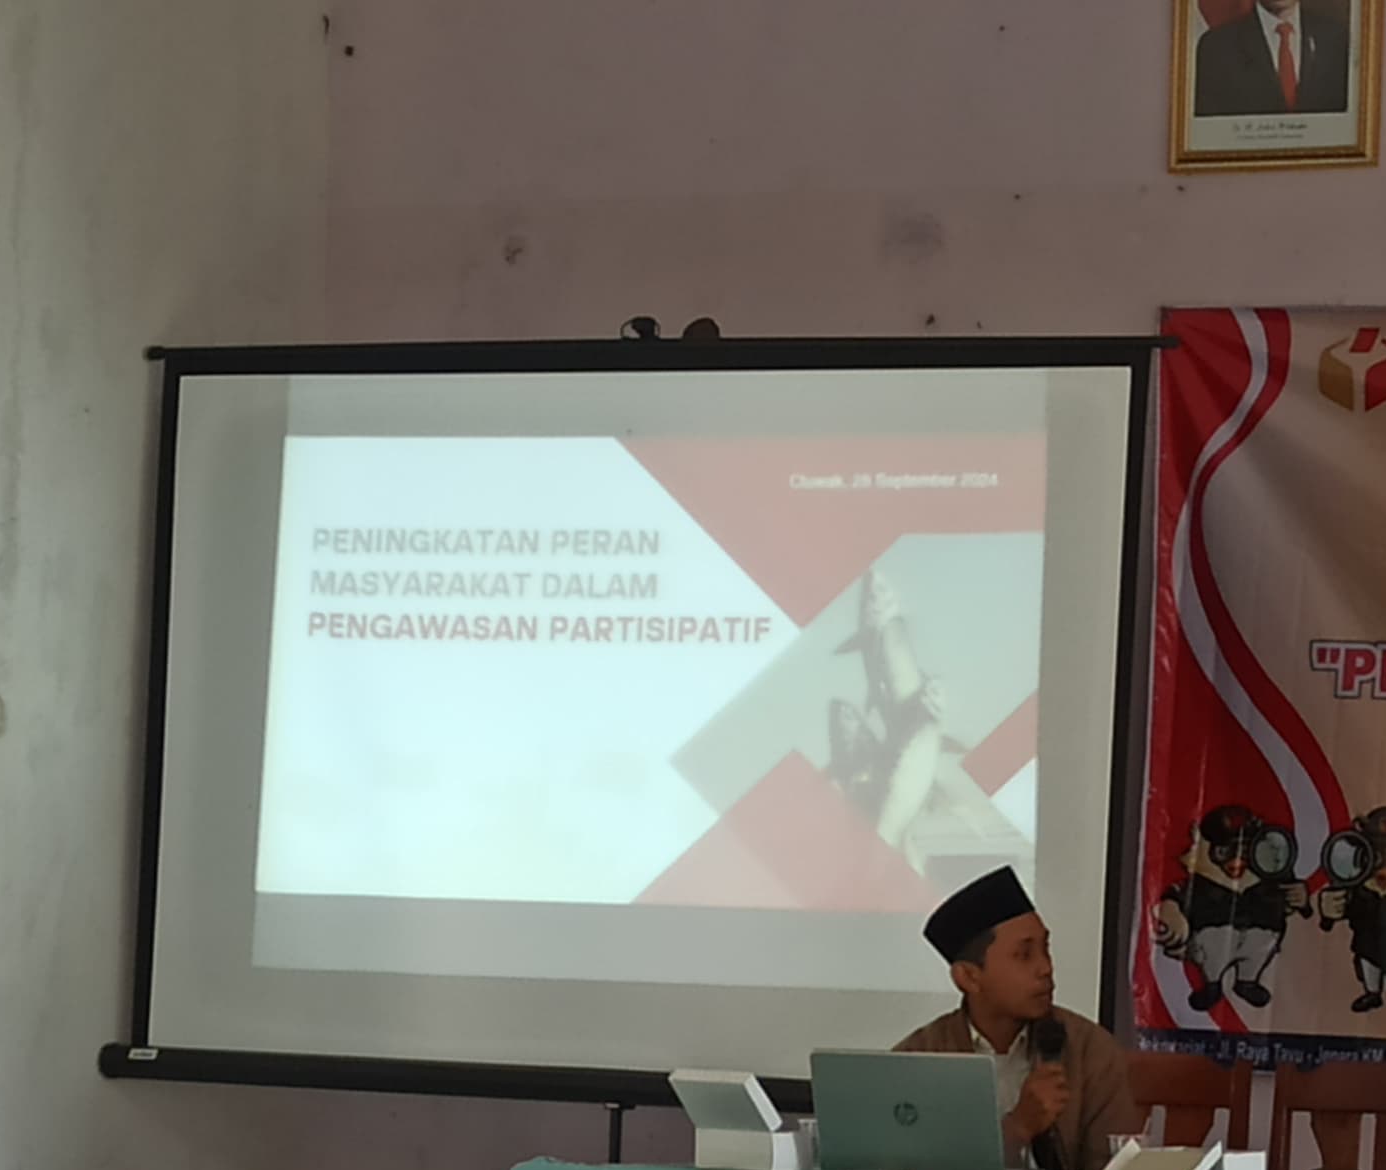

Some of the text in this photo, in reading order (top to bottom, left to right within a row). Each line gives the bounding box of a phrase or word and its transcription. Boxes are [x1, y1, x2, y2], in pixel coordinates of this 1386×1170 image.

[312, 526, 660, 556] PENINGKATAN PERAN
[310, 570, 659, 599] MASYARAKAT DALAM
[307, 612, 772, 643] PENGAWASAN PARTISIPATIF
